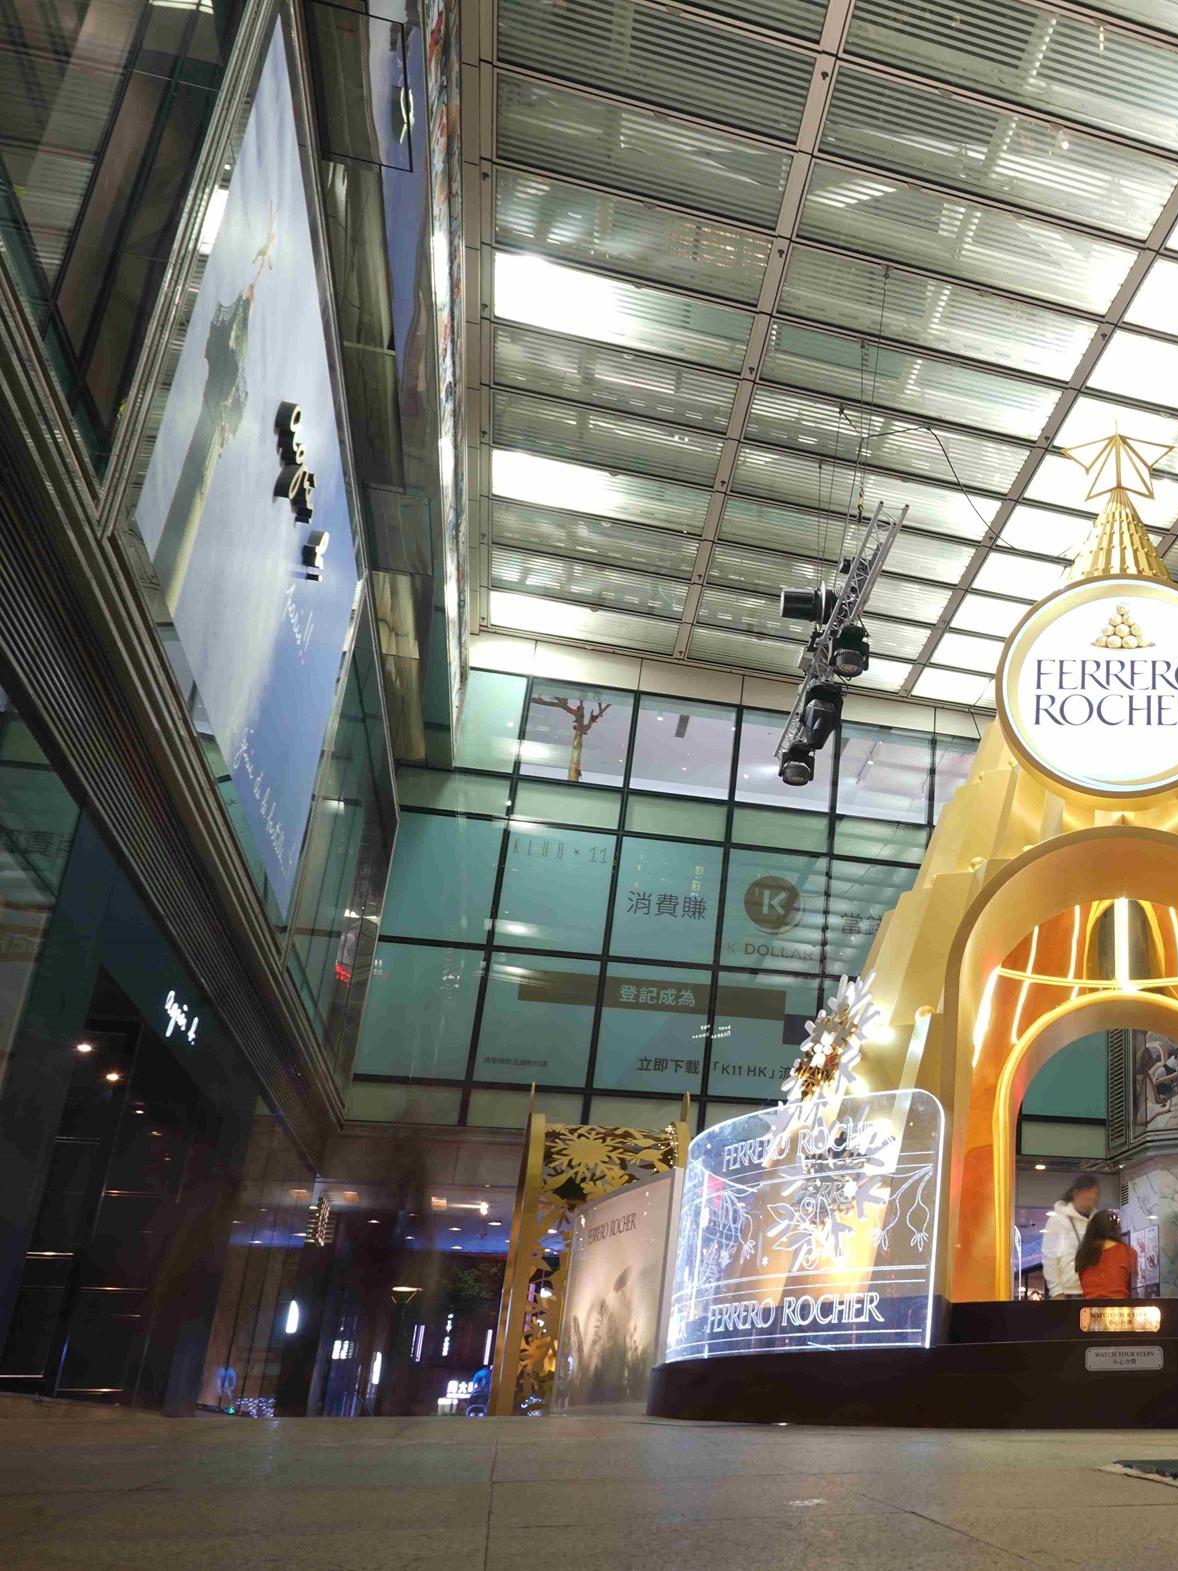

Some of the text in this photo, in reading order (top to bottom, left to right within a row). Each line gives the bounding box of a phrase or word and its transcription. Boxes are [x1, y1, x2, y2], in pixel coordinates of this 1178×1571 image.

[626, 890, 709, 921] 消費賺
[618, 984, 696, 1008] 登記成為
[637, 1056, 701, 1075] 立即下載
[610, 1212, 637, 1238] ROCHER
[706, 1298, 775, 1333] FERRERO
[781, 1291, 885, 1327] ROCHER
